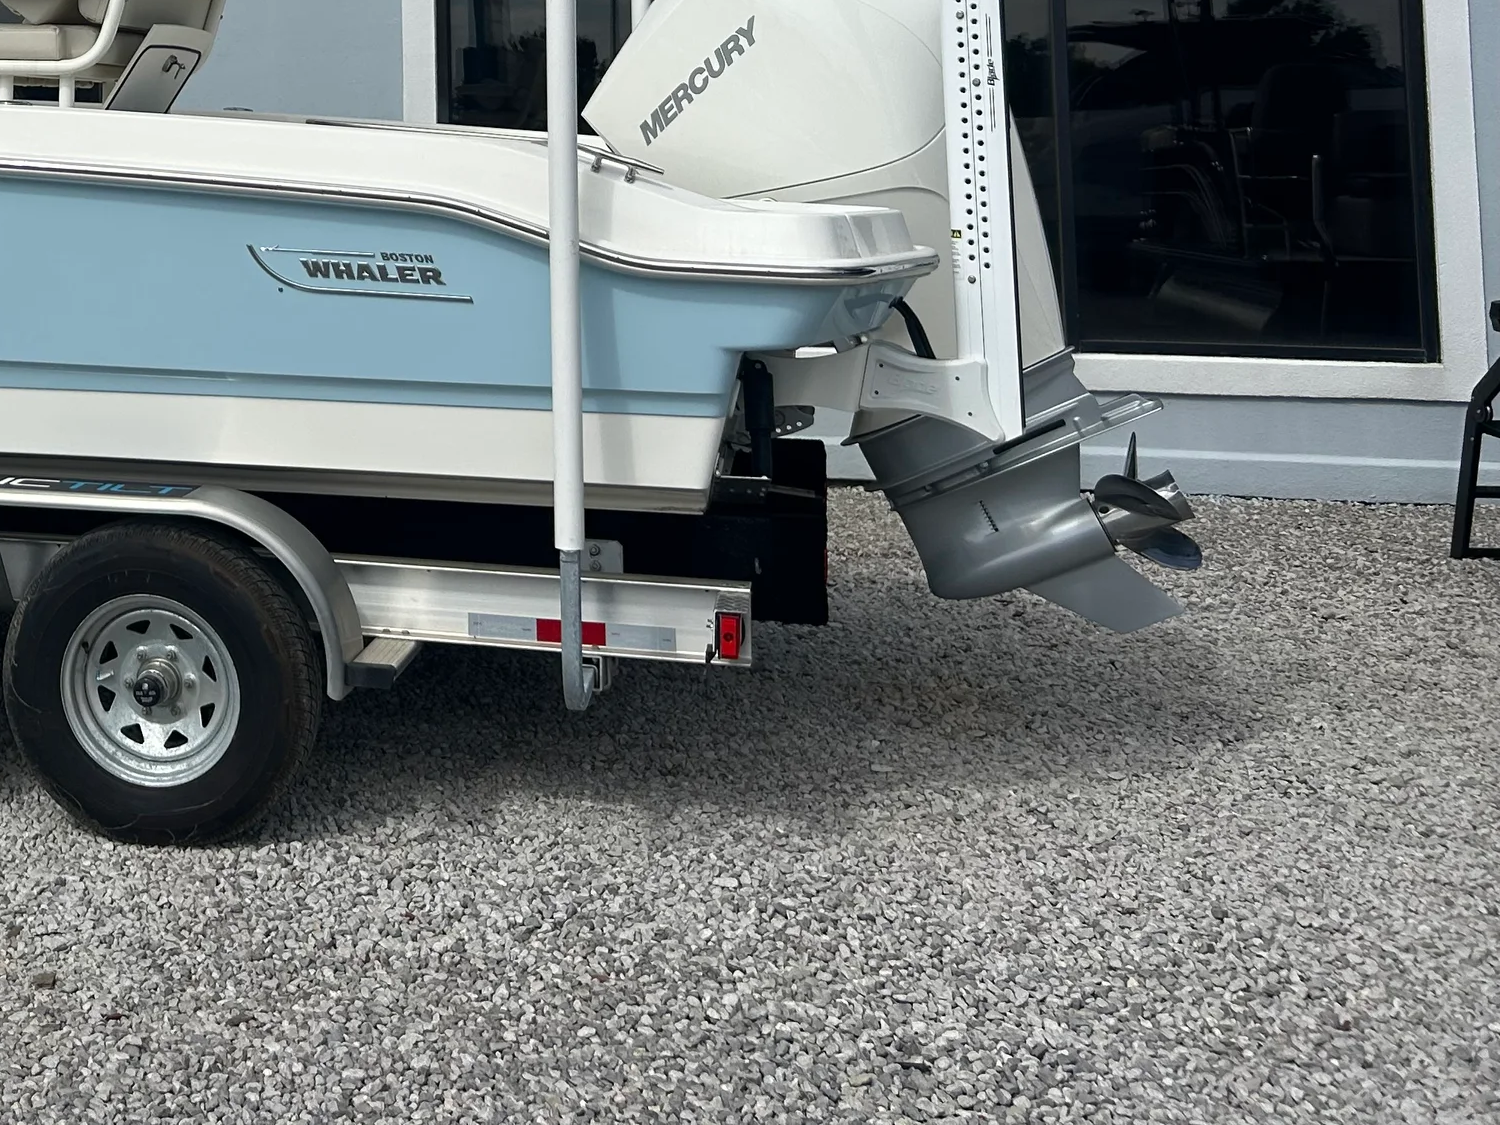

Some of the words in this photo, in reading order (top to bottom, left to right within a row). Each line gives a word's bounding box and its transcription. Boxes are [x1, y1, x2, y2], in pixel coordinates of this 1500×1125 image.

[639, 15, 756, 146] MERCURY
[299, 258, 447, 286] WHALER
[380, 252, 434, 264] BOSTON
